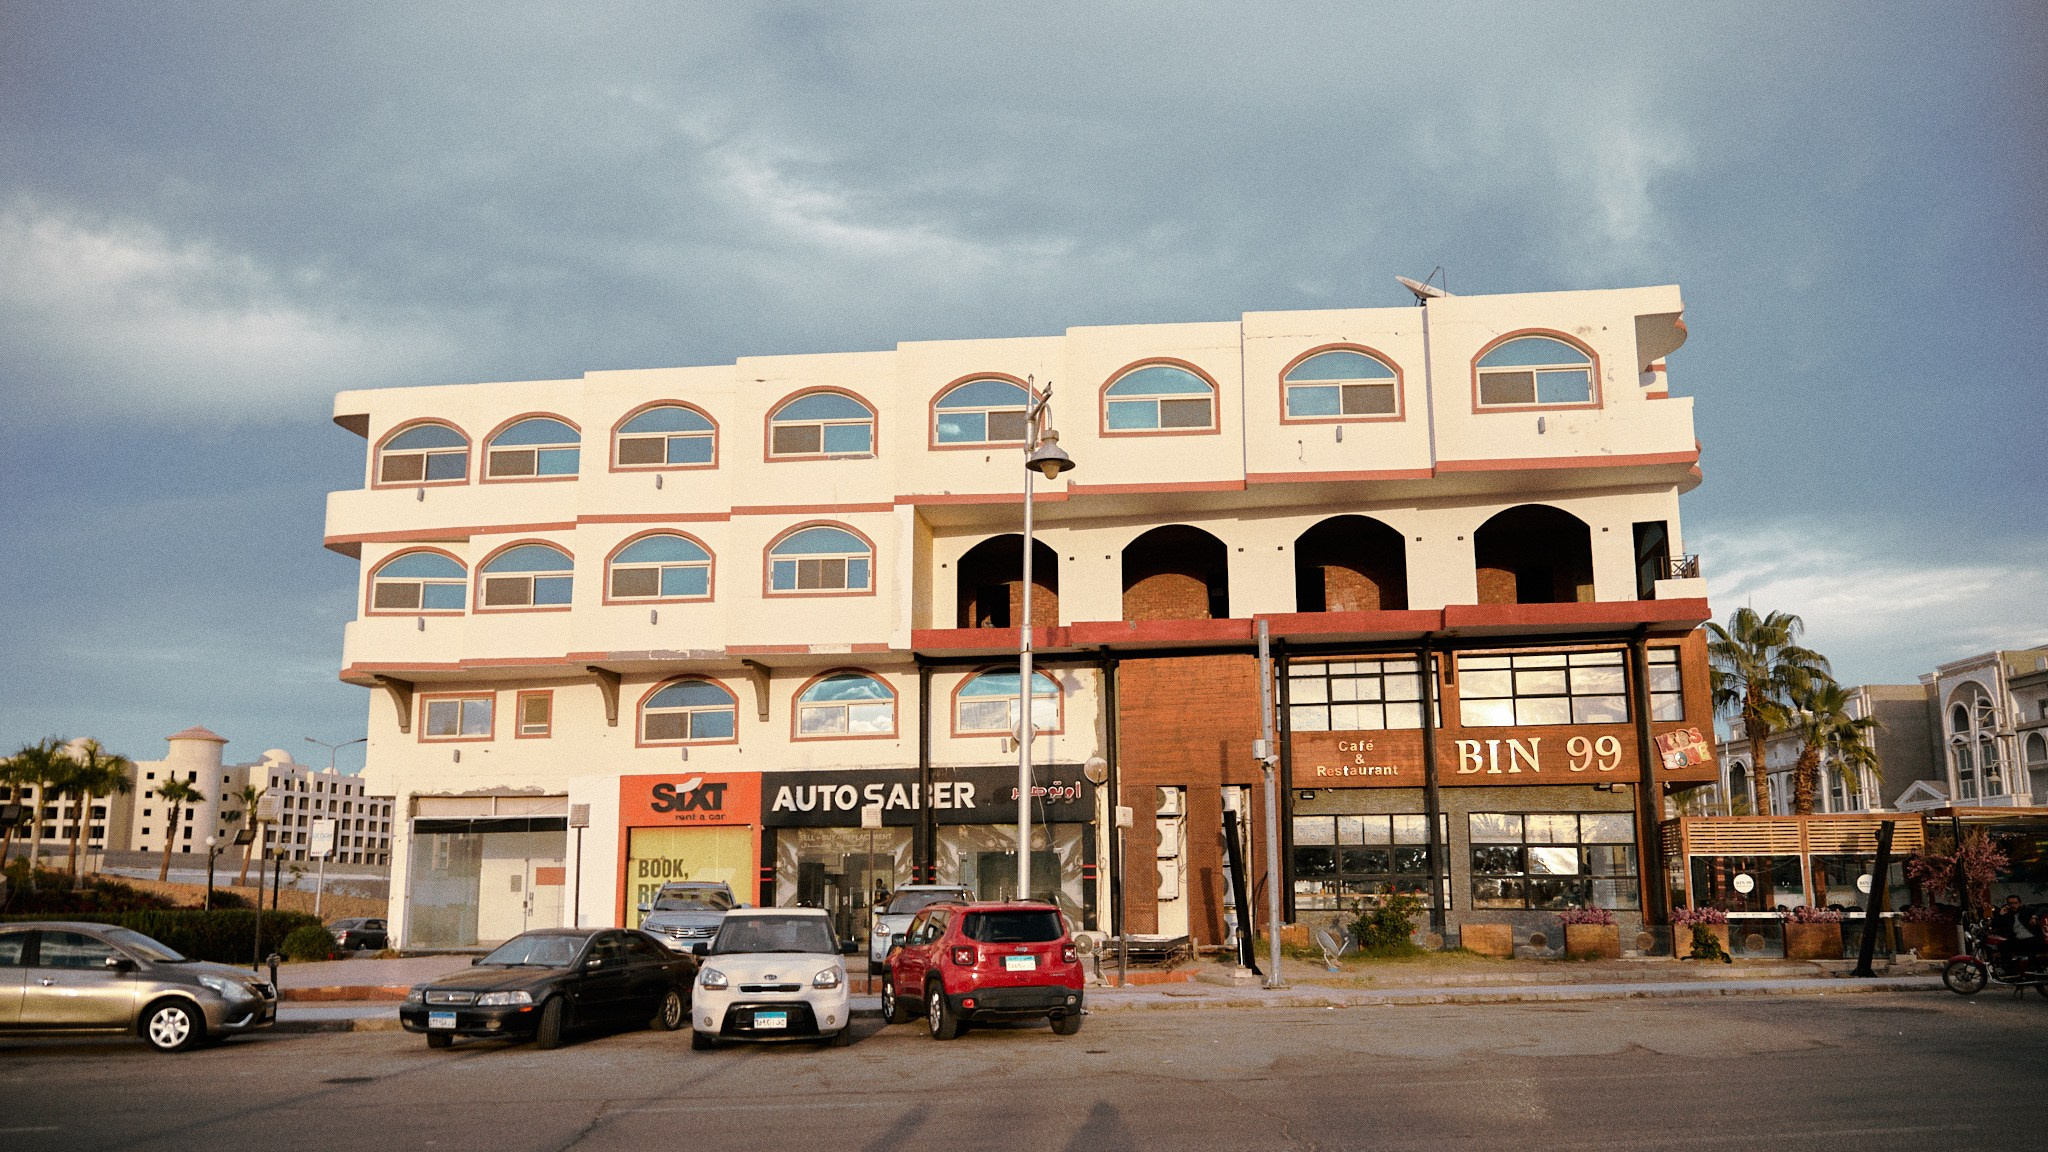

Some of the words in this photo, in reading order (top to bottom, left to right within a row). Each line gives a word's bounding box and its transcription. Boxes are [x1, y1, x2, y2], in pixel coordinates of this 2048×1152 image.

[1338, 739, 1374, 752] Café
[1355, 753, 1365, 765] &
[1455, 737, 1541, 774] BIN
[1566, 735, 1622, 772] 99
[1316, 765, 1398, 777] Restaurant
[771, 785, 858, 812] AUTO
[675, 813, 696, 821] rent
[638, 858, 689, 880] BOOK,
